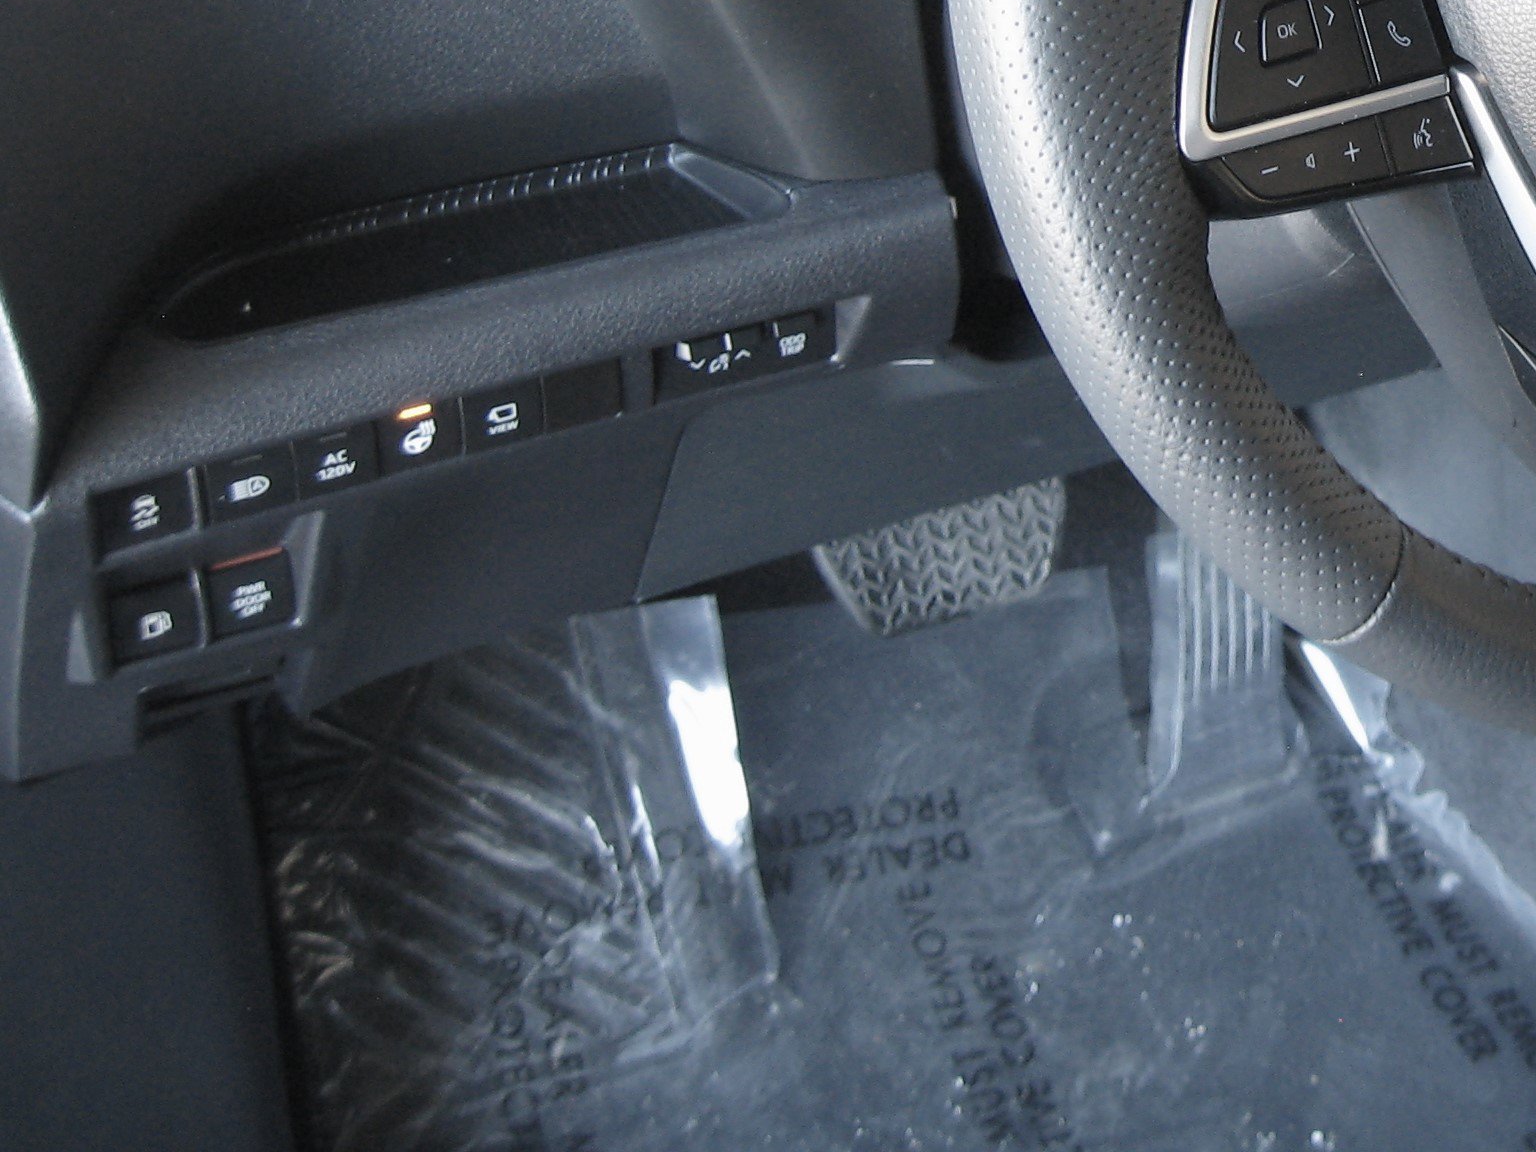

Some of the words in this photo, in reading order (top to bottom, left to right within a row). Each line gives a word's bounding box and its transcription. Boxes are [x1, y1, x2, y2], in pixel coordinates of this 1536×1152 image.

[1276, 22, 1298, 40] OK
[487, 419, 519, 435] VIEW
[323, 448, 348, 466] AC
[315, 461, 356, 481] 120V
